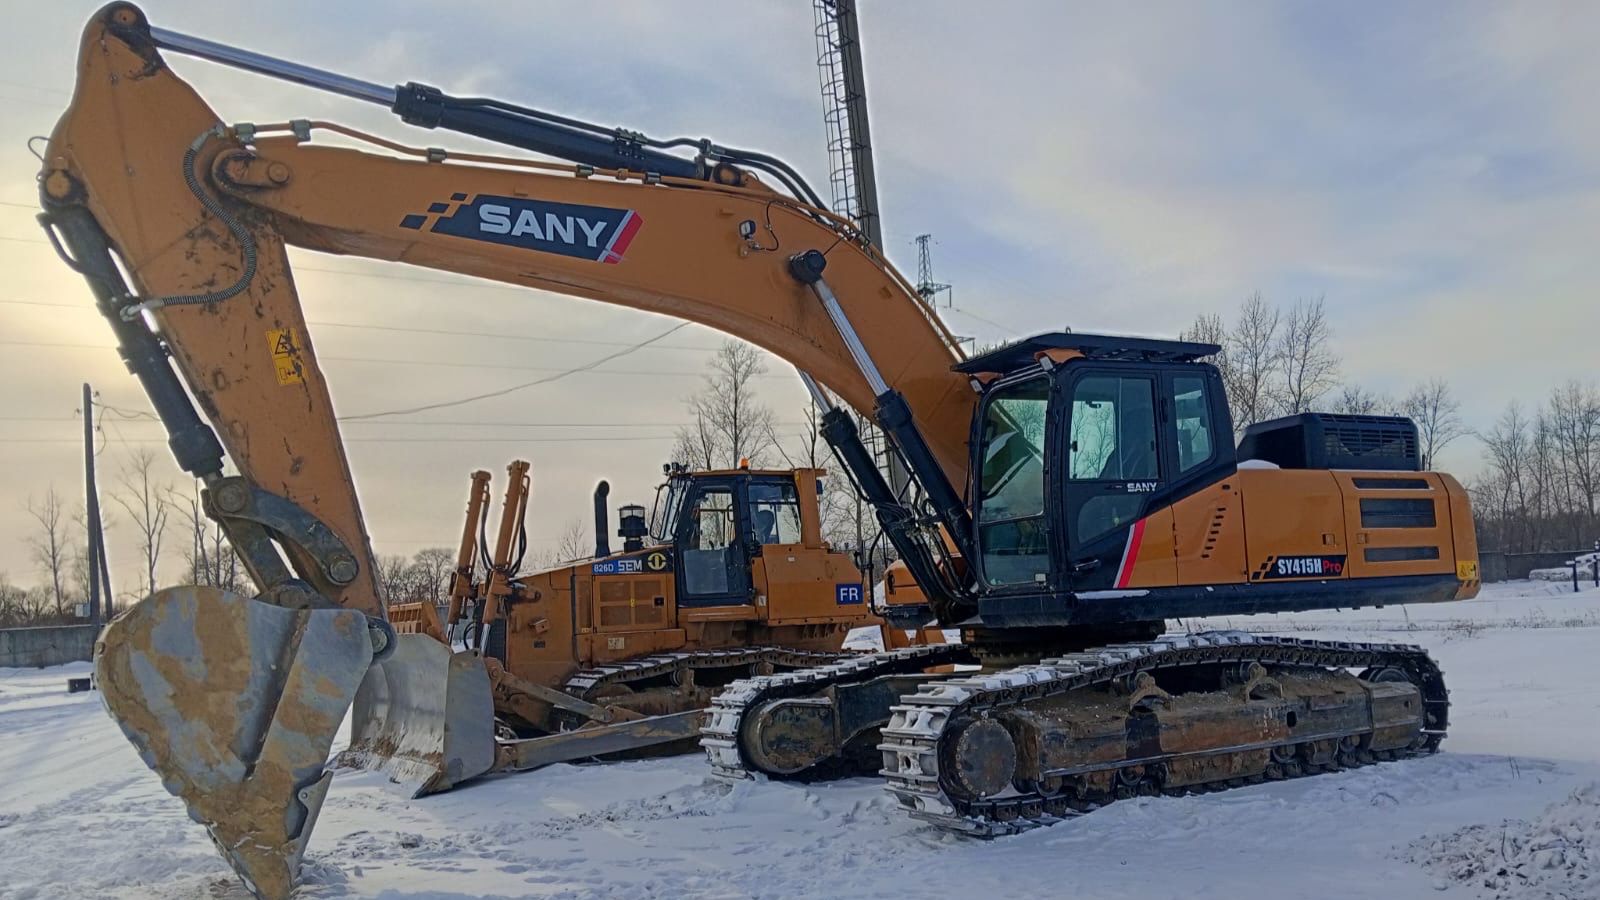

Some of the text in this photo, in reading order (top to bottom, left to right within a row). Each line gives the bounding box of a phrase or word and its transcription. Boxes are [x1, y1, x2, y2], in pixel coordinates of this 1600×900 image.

[479, 203, 607, 248] SANY
[1127, 482, 1157, 492] SANY
[594, 560, 642, 573] 826D SEM
[840, 587, 859, 601] FR
